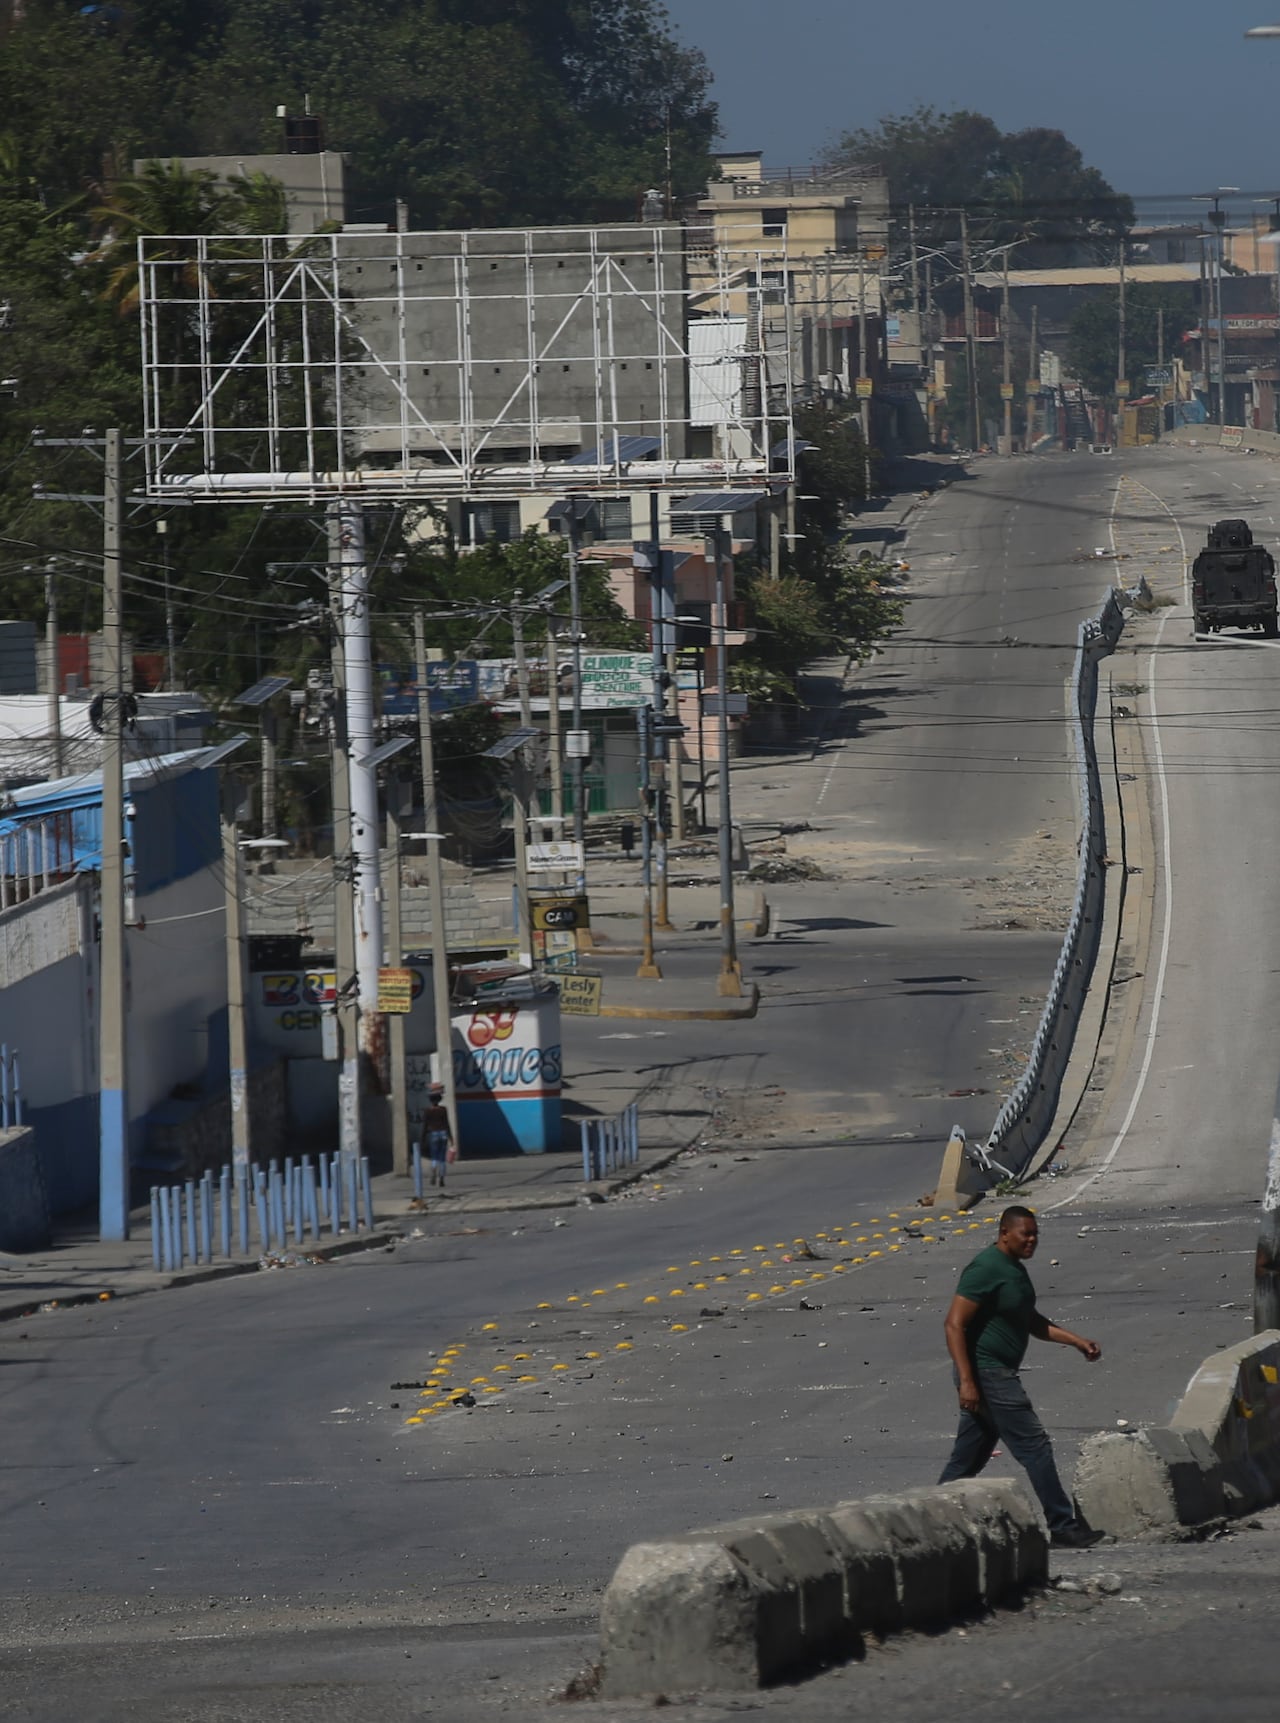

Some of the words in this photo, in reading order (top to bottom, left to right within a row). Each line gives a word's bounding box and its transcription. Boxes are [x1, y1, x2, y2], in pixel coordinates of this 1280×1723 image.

[583, 656, 635, 670] CLINIQUE
[546, 911, 573, 923] CAM
[564, 977, 596, 995] Lesly
[560, 993, 594, 1006] Center
[281, 1010, 321, 1031] CEN
